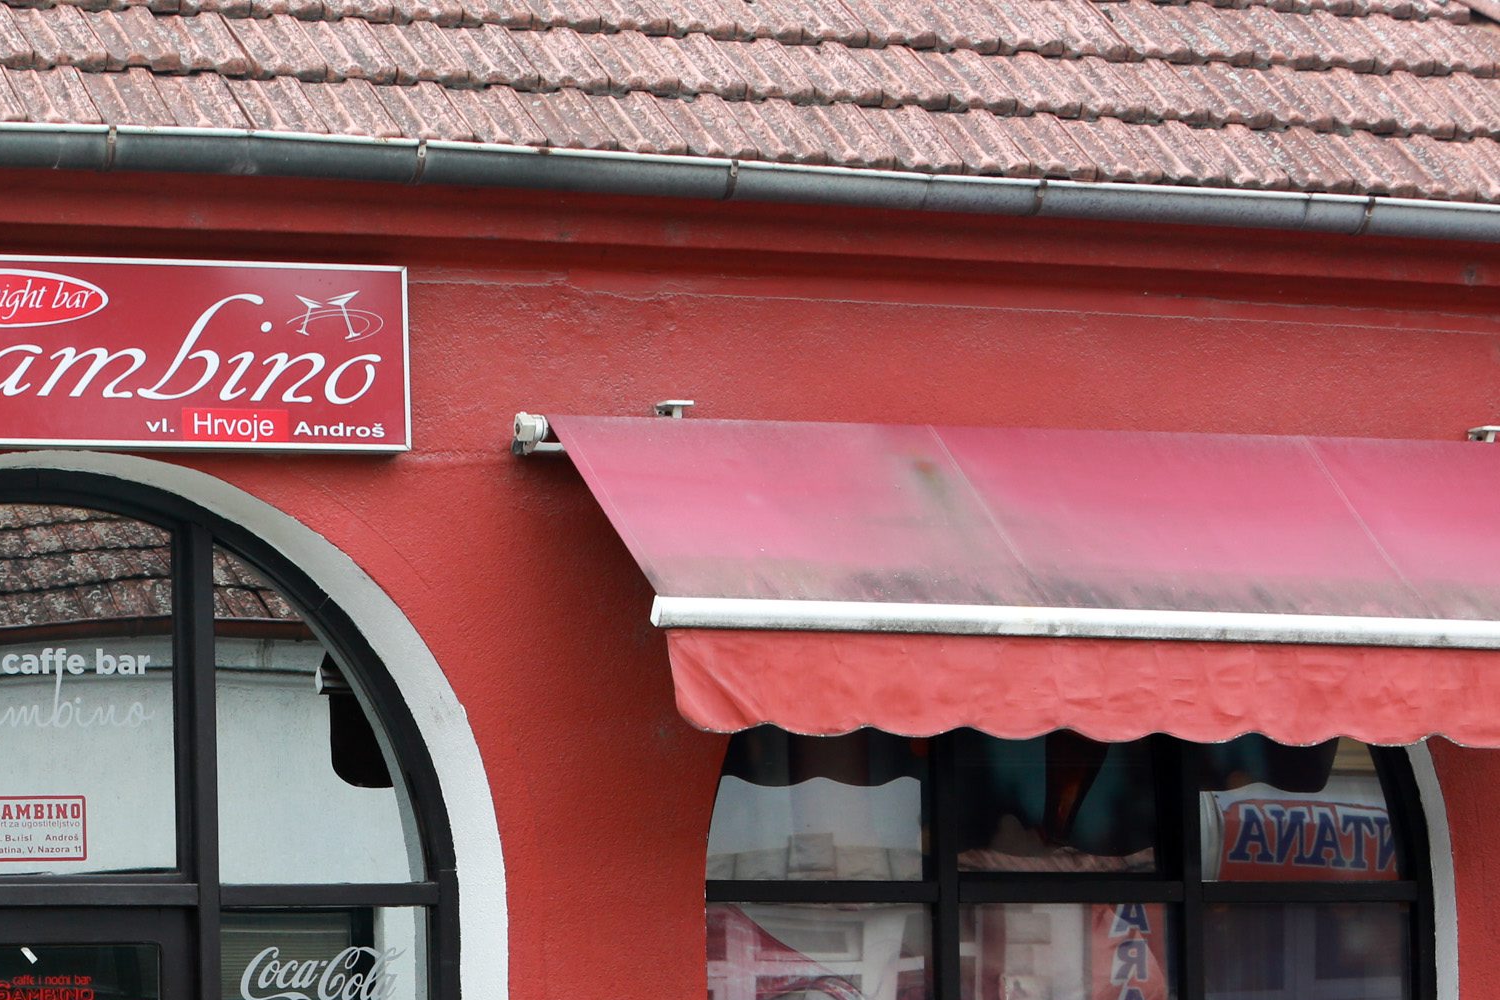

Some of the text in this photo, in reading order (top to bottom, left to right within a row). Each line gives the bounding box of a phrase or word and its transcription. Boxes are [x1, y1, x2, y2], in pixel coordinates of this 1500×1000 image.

[51, 281, 96, 309] bar
[146, 411, 386, 442] vl. Hrvoje Androš
[2, 648, 151, 675] caffe bar
[21, 820, 80, 829] ugostiteljstvo
[45, 833, 79, 842] Androš
[37, 845, 70, 854] Nazora
[73, 845, 82, 853] 11
[74, 974, 92, 985] bar
